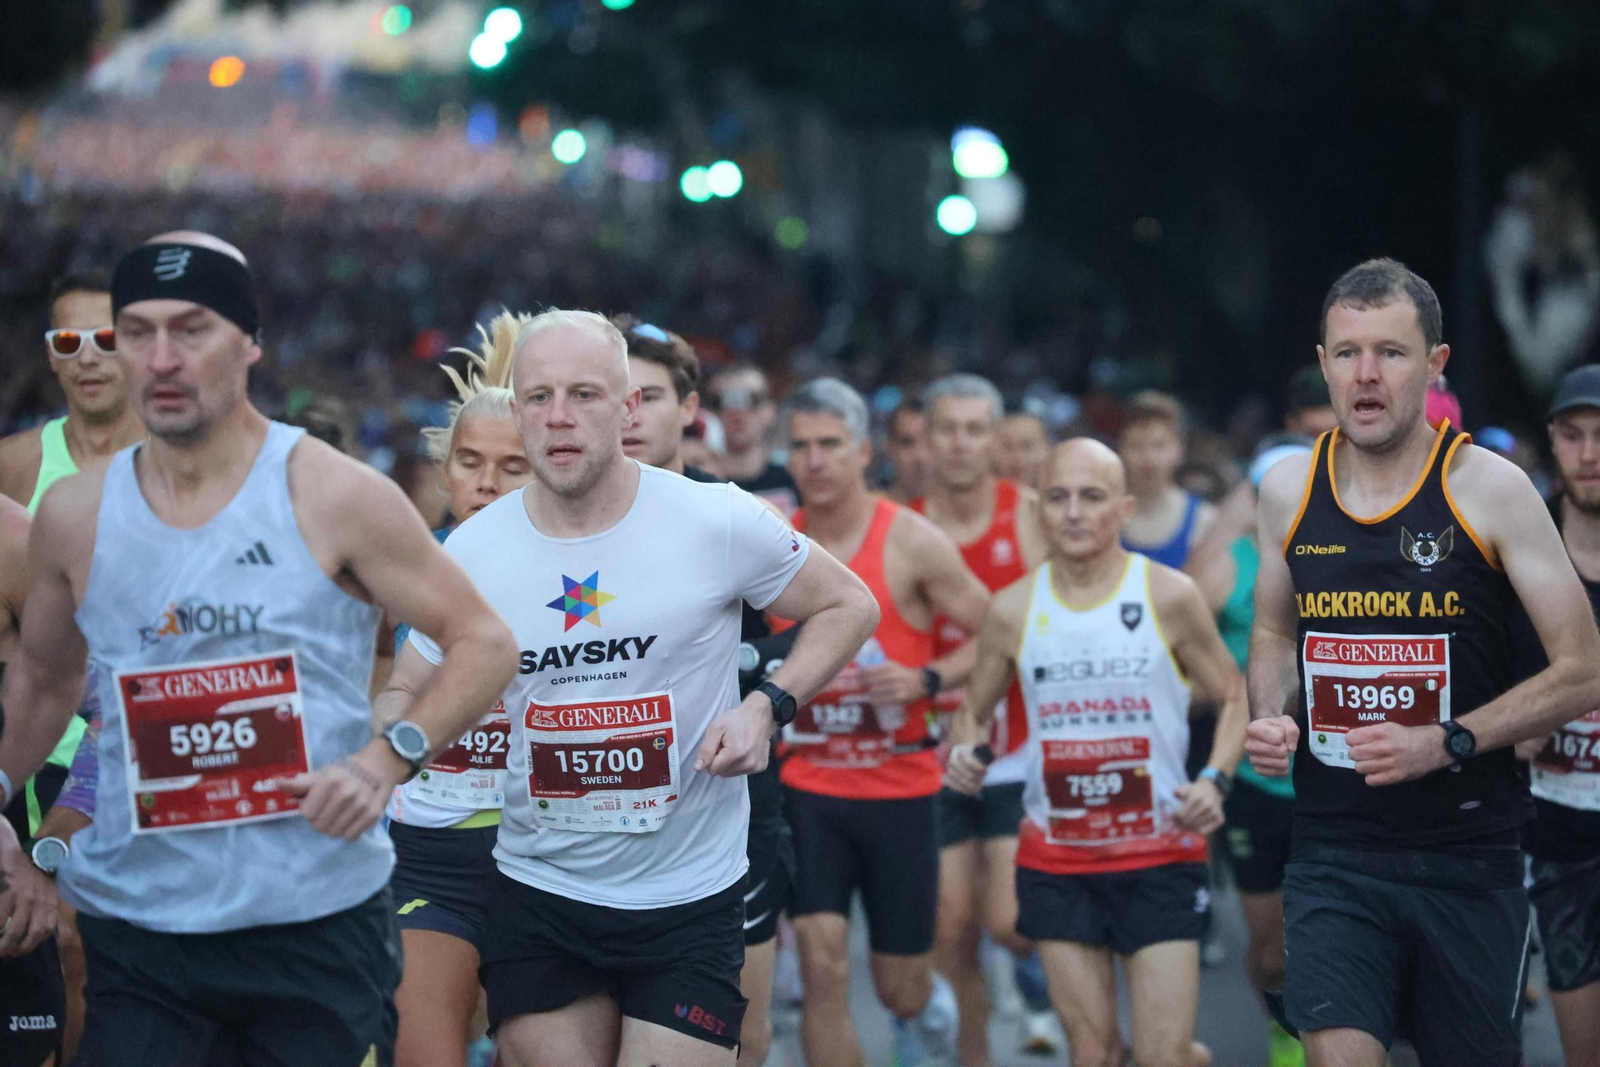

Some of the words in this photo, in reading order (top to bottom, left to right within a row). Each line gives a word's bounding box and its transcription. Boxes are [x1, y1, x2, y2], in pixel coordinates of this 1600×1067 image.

[1296, 544, 1346, 555] O'Neills
[1295, 591, 1412, 618] LACKROCK
[1419, 591, 1465, 617] A.C.
[519, 635, 658, 675] SAYSKY
[1338, 642, 1435, 662] GENERALI
[550, 671, 628, 685] COPENHAGEN
[1333, 683, 1415, 710] 13969
[558, 700, 661, 728] GENERALI
[1358, 712, 1387, 721] MARK
[169, 717, 257, 756] 5926
[448, 730, 512, 753] 492
[192, 751, 240, 768] ROBERT
[469, 755, 494, 764] JULIE
[554, 747, 644, 774] 15700
[580, 775, 622, 785] SWEDEN
[633, 799, 657, 810] 21K
[687, 1004, 727, 1035] BST
